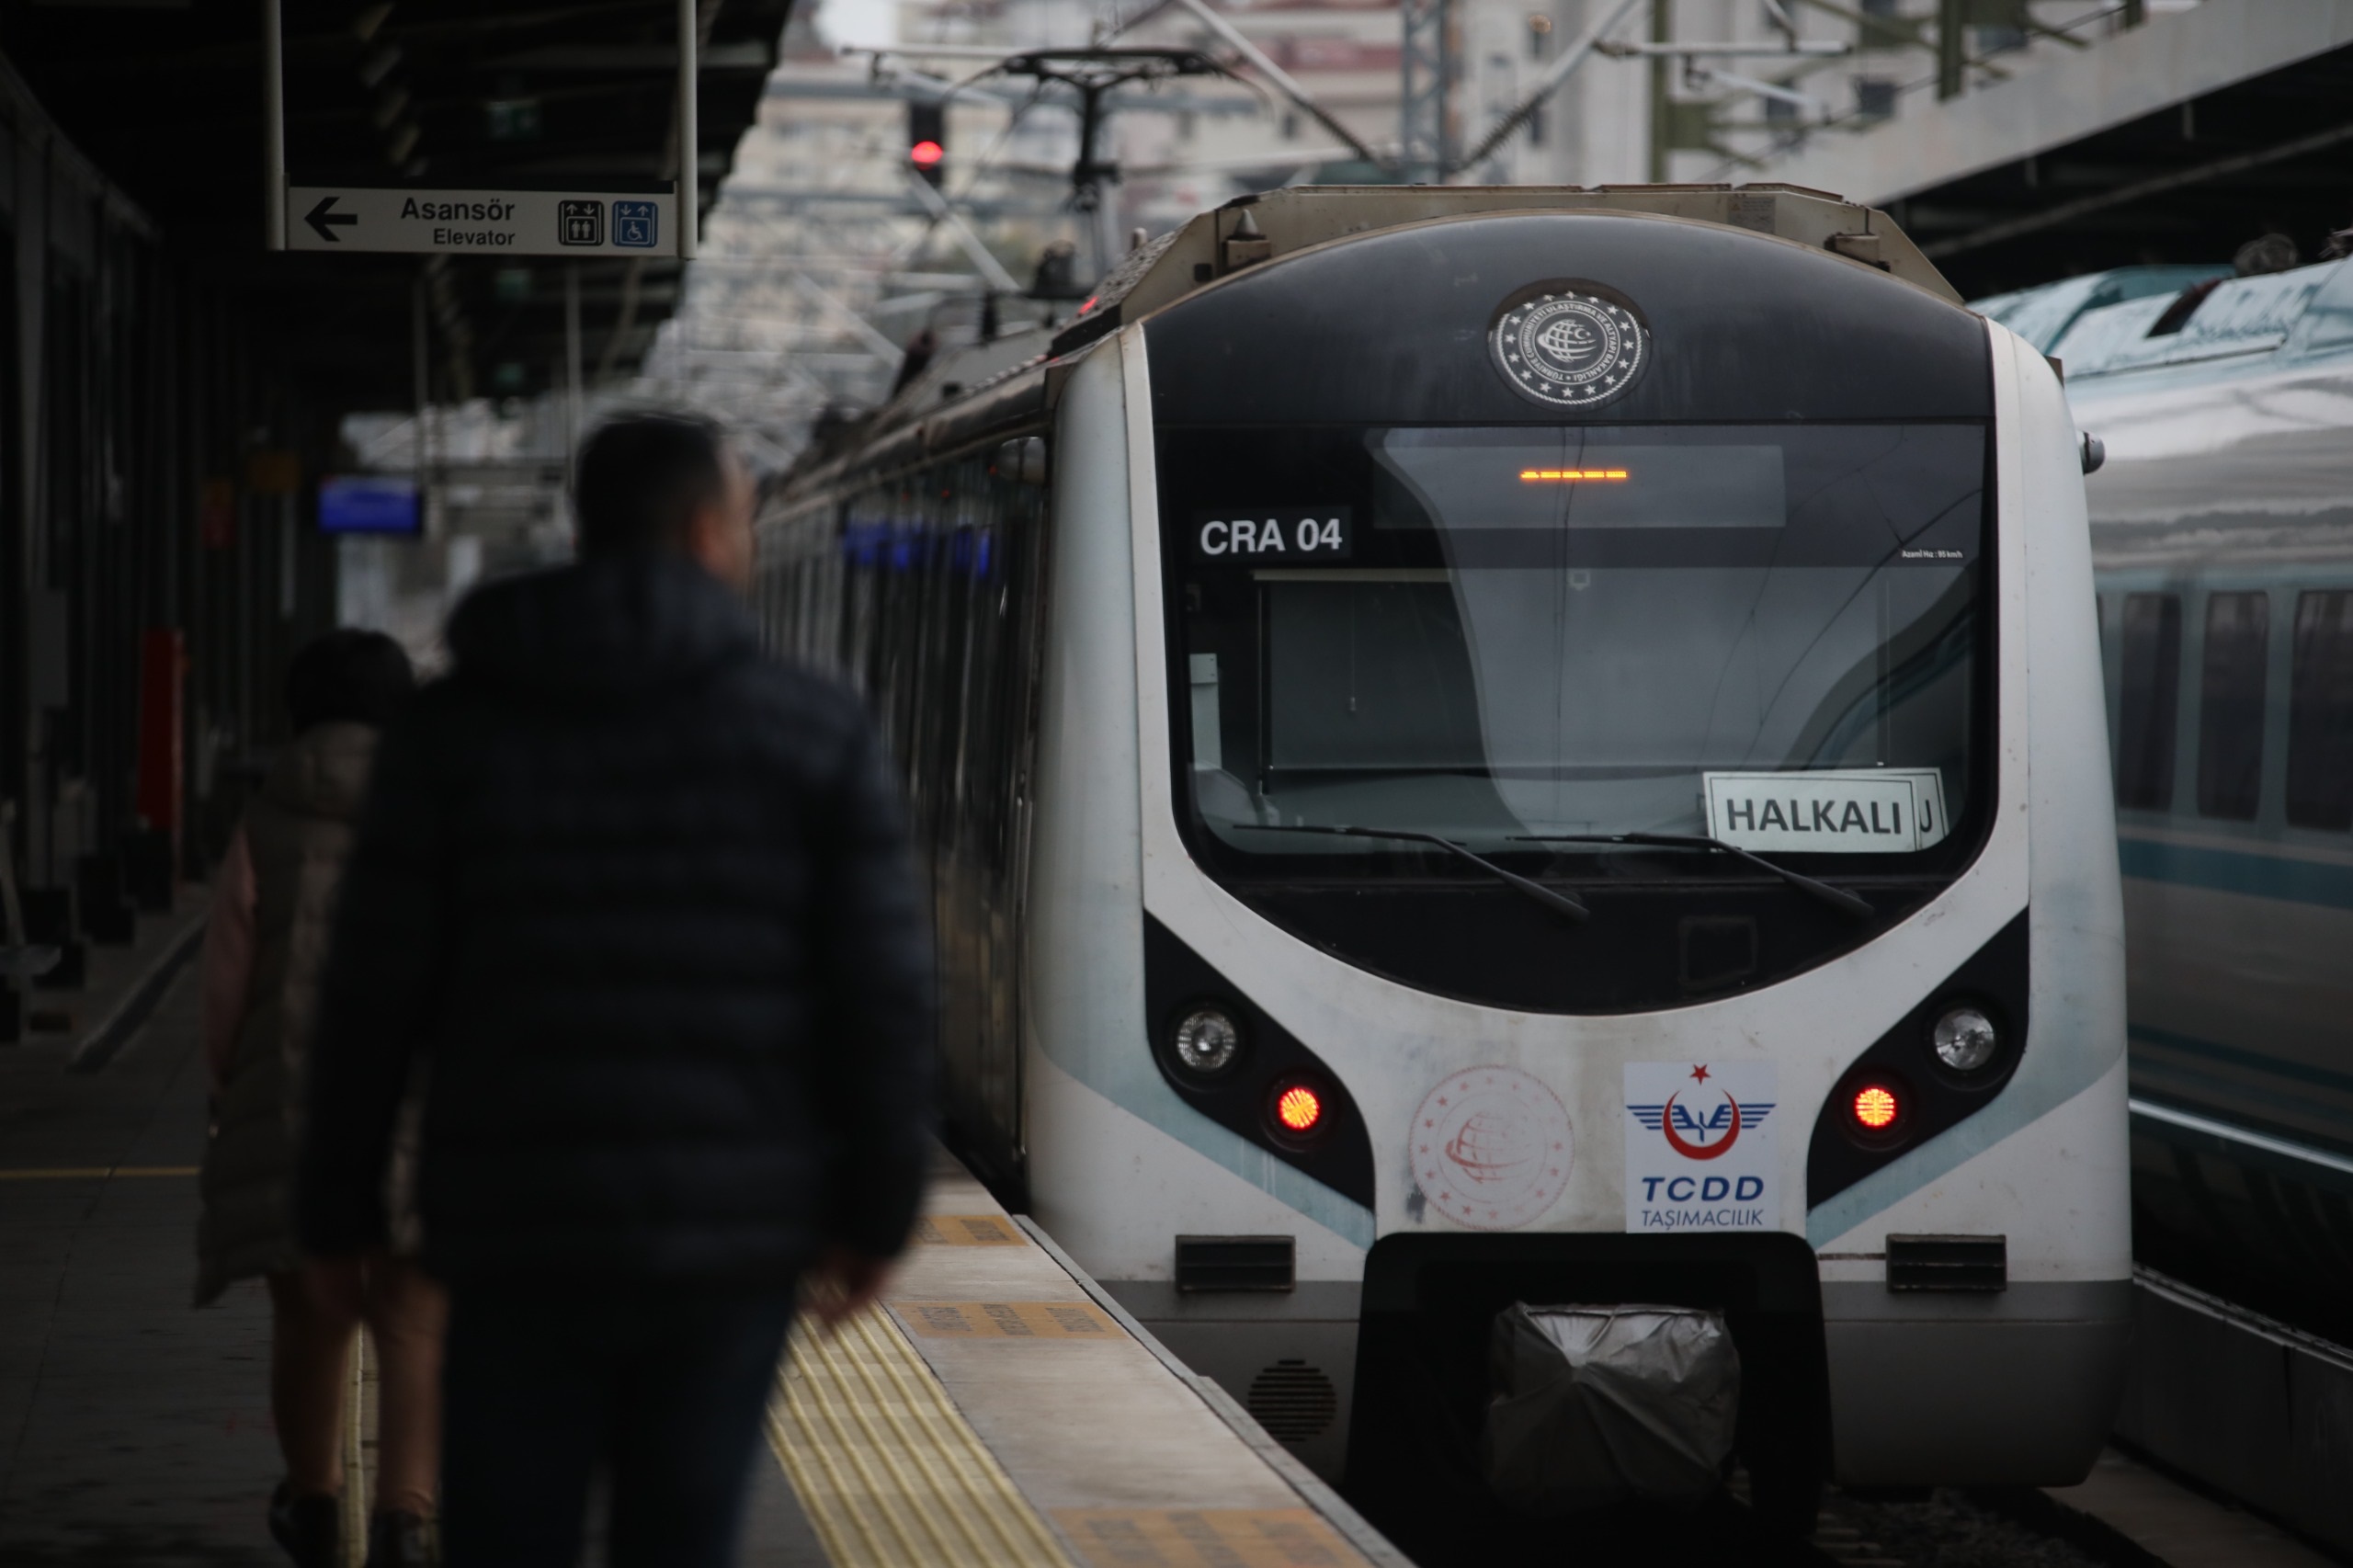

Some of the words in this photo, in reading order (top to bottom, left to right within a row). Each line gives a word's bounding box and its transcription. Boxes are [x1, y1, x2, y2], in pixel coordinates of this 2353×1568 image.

[401, 197, 515, 221] Asansör
[433, 228, 515, 245] Elevator
[1546, 303, 1597, 317] ULAŞTIRMA
[1597, 312, 1608, 324] VE
[1603, 323, 1618, 355] ALTYAPI
[1530, 355, 1564, 381] TÜRKİYE
[1574, 353, 1615, 382] BAKANLIĞI
[1200, 519, 1286, 555] CRA
[1296, 518, 1343, 551] 04
[1726, 799, 1902, 835] HALKALI
[1642, 1176, 1764, 1202] TCDD
[1642, 1209, 1764, 1231] TAŞIMACILIK
